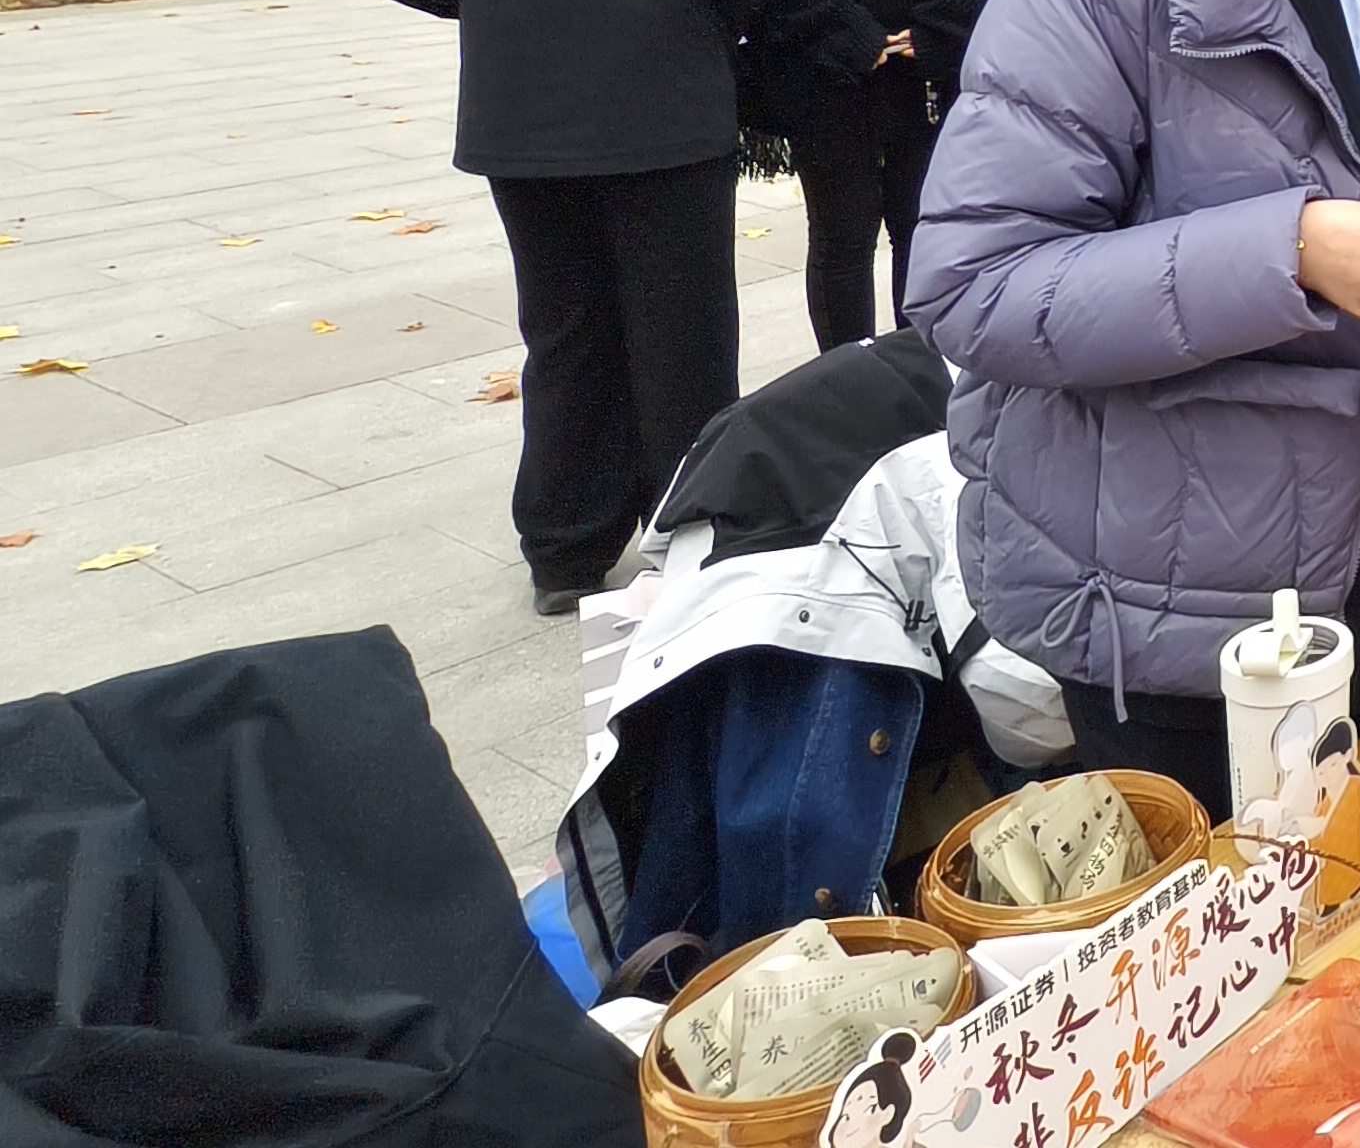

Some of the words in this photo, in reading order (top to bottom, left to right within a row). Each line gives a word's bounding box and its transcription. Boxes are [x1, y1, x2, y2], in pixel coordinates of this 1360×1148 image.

[959, 970, 1056, 1053] 开源证券
[1076, 863, 1208, 973] 投资者教育基地
